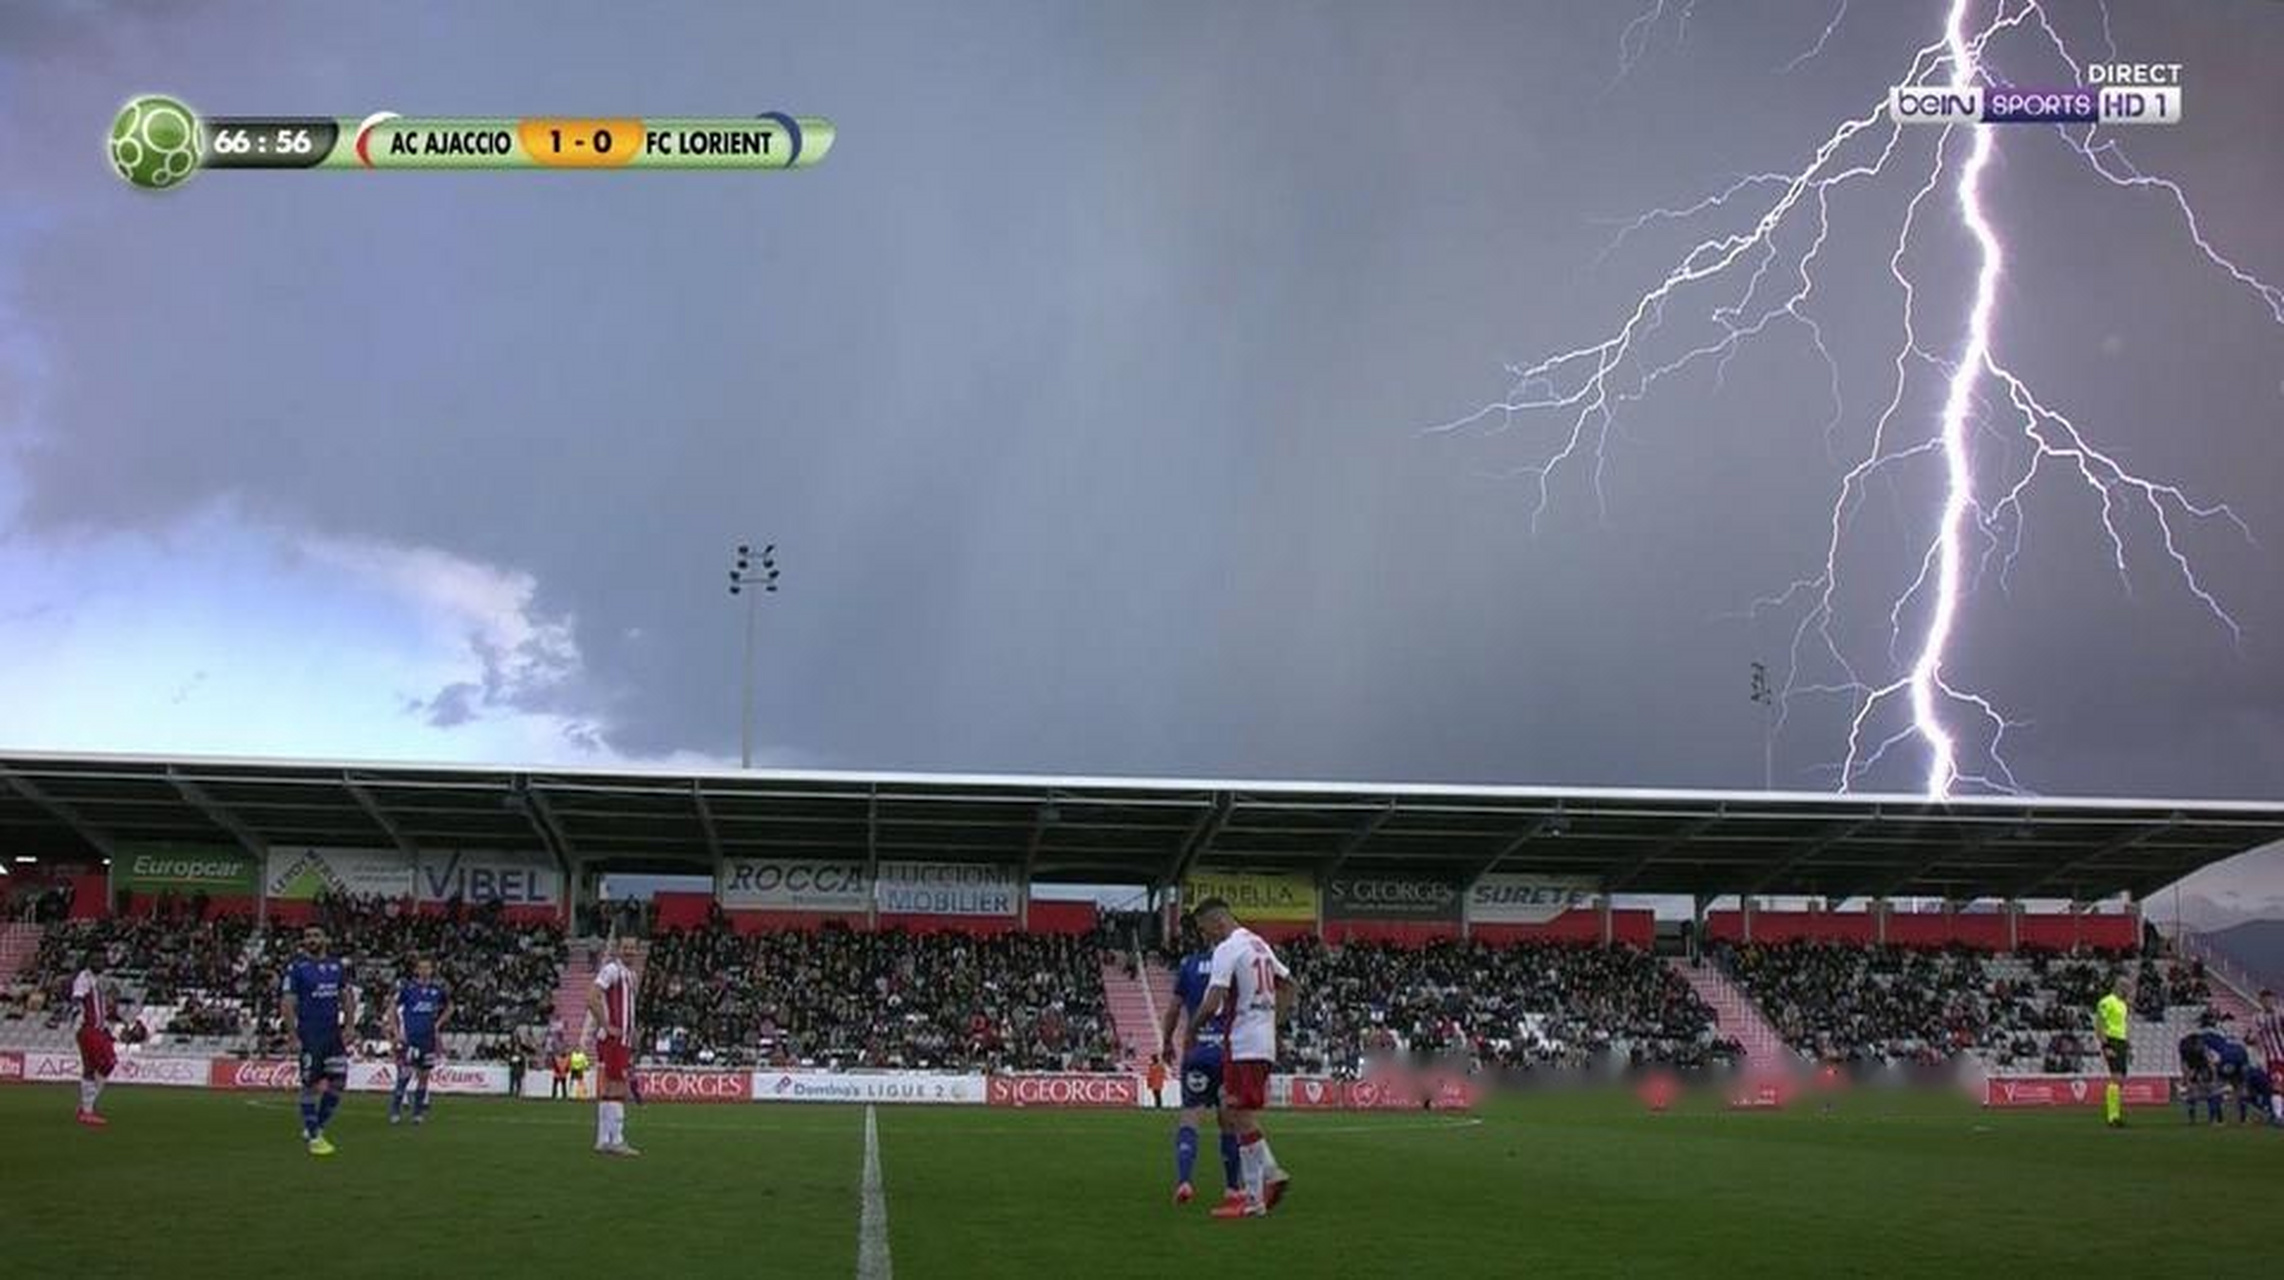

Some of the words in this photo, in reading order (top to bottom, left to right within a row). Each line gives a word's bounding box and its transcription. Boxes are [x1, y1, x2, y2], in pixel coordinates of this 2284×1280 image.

[133, 855, 244, 879] Europcar
[423, 851, 549, 901] VIBEL
[728, 864, 867, 893] ROCCA
[868, 1085, 924, 1098] LIGUE
[936, 1086, 945, 1098] 2
[1018, 1079, 1130, 1103] GEORGES
